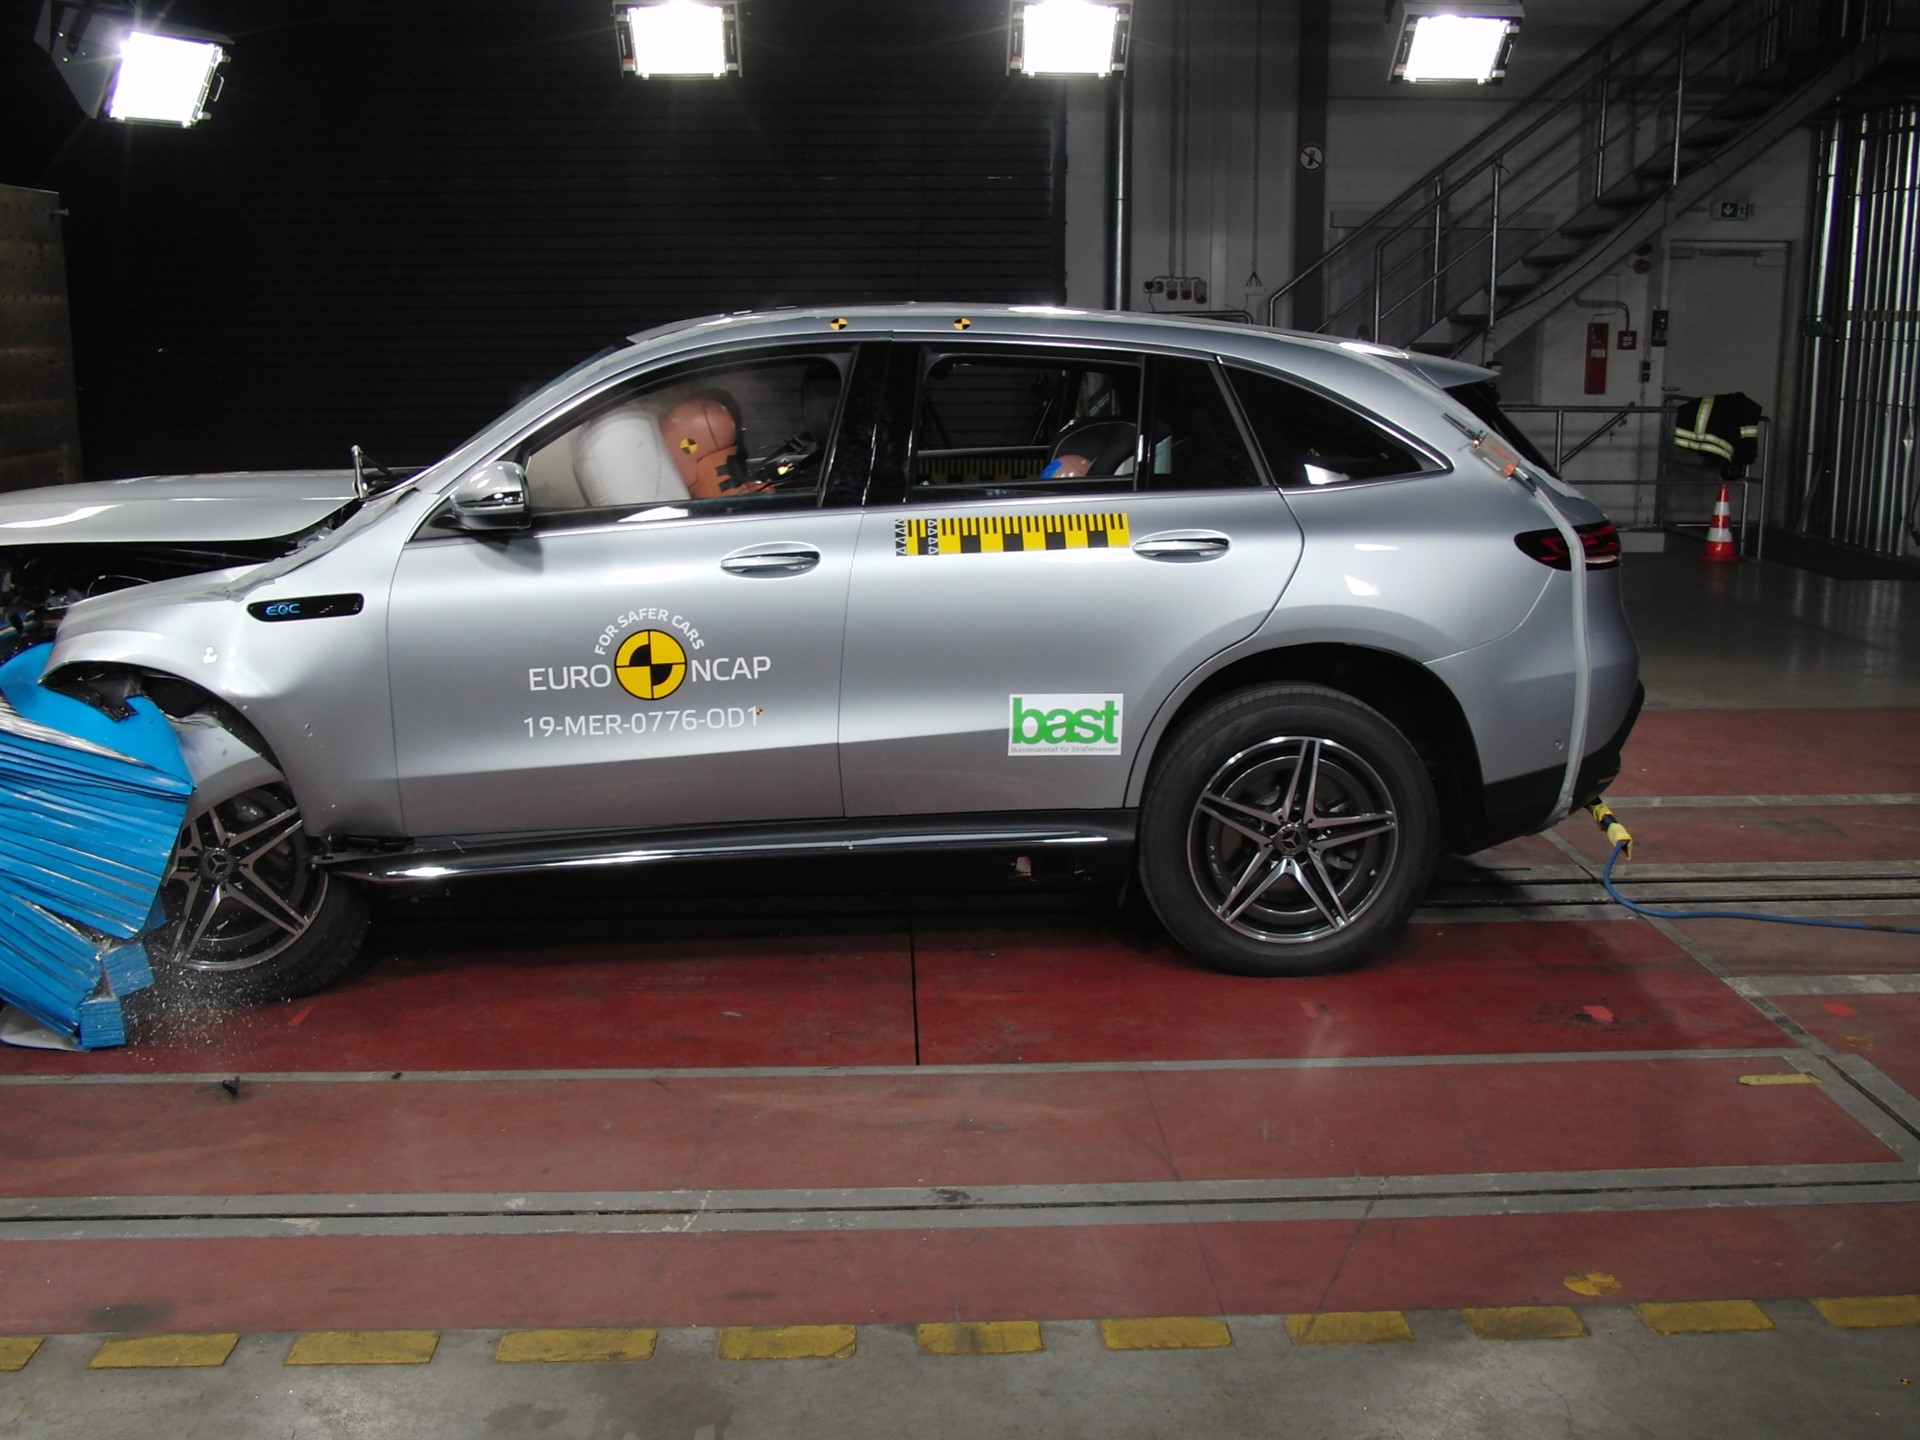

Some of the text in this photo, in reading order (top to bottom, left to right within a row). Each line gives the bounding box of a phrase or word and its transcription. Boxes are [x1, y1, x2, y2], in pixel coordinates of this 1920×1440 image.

[266, 603, 300, 616] EQC
[594, 607, 705, 655] FOR SAFER CARS
[528, 656, 772, 691] EURO NCAP
[1012, 697, 1119, 744] bast
